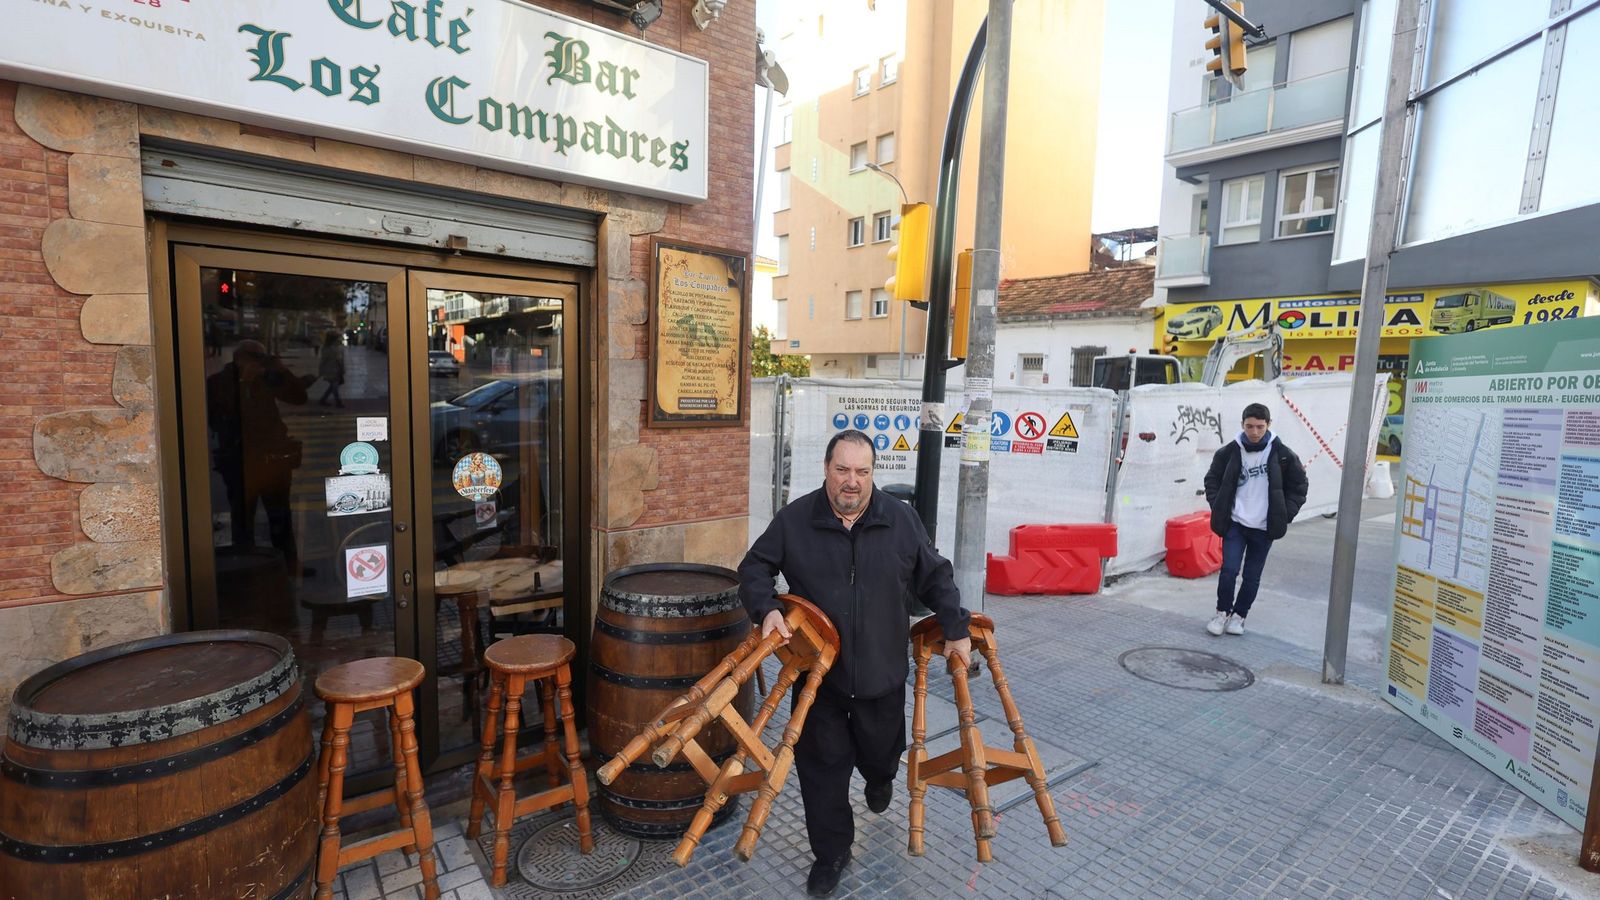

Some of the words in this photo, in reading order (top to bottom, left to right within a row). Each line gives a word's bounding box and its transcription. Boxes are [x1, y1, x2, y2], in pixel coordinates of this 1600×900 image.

[80, 4, 92, 14] Y
[101, 9, 206, 42] EXQUISITA
[328, 0, 472, 54] Café
[544, 31, 640, 100] Bar
[238, 23, 380, 106] Los
[425, 75, 690, 172] Compadres
[1528, 290, 1575, 306] desde
[1523, 306, 1580, 325] 1984
[1489, 377, 1543, 392] ABIERTO
[1547, 376, 1578, 390] POR
[1524, 394, 1553, 402] HILERA
